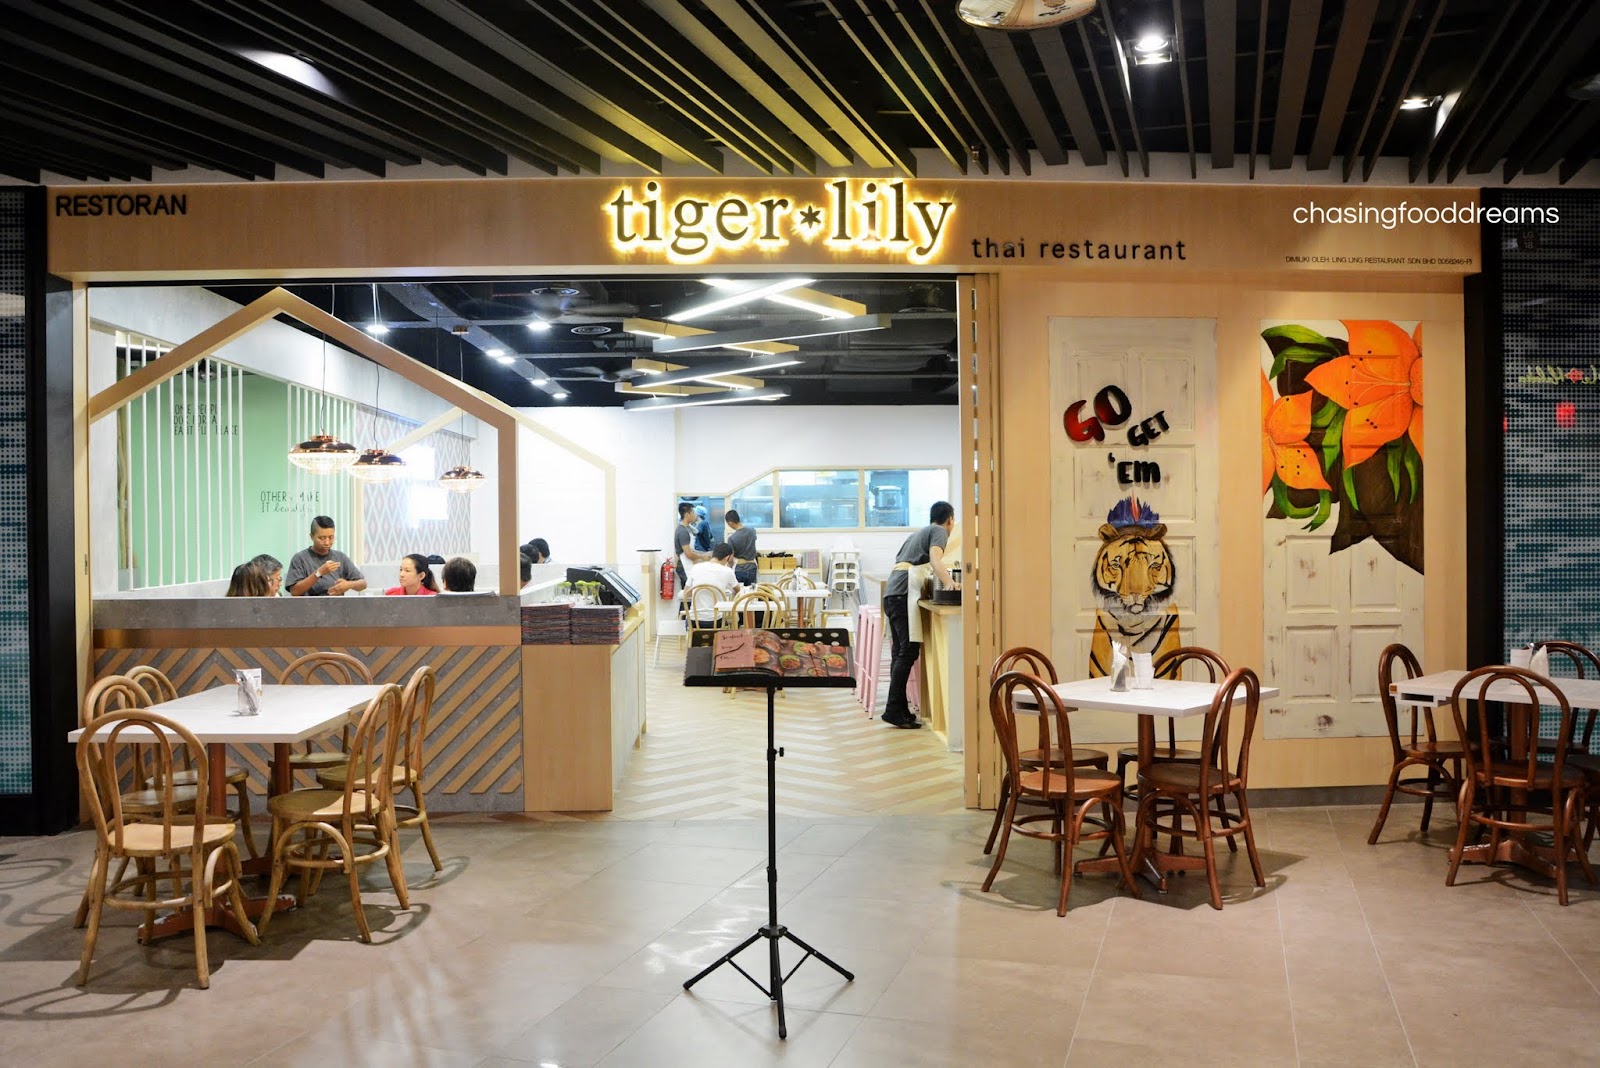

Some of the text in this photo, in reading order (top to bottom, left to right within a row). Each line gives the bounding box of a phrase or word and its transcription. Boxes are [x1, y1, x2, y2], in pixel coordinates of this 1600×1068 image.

[56, 194, 187, 217] RESTORAN
[611, 180, 954, 256] tiger lily
[972, 238, 1187, 260] thai restaurant
[1063, 385, 1132, 441] GO
[1127, 411, 1169, 446] GET
